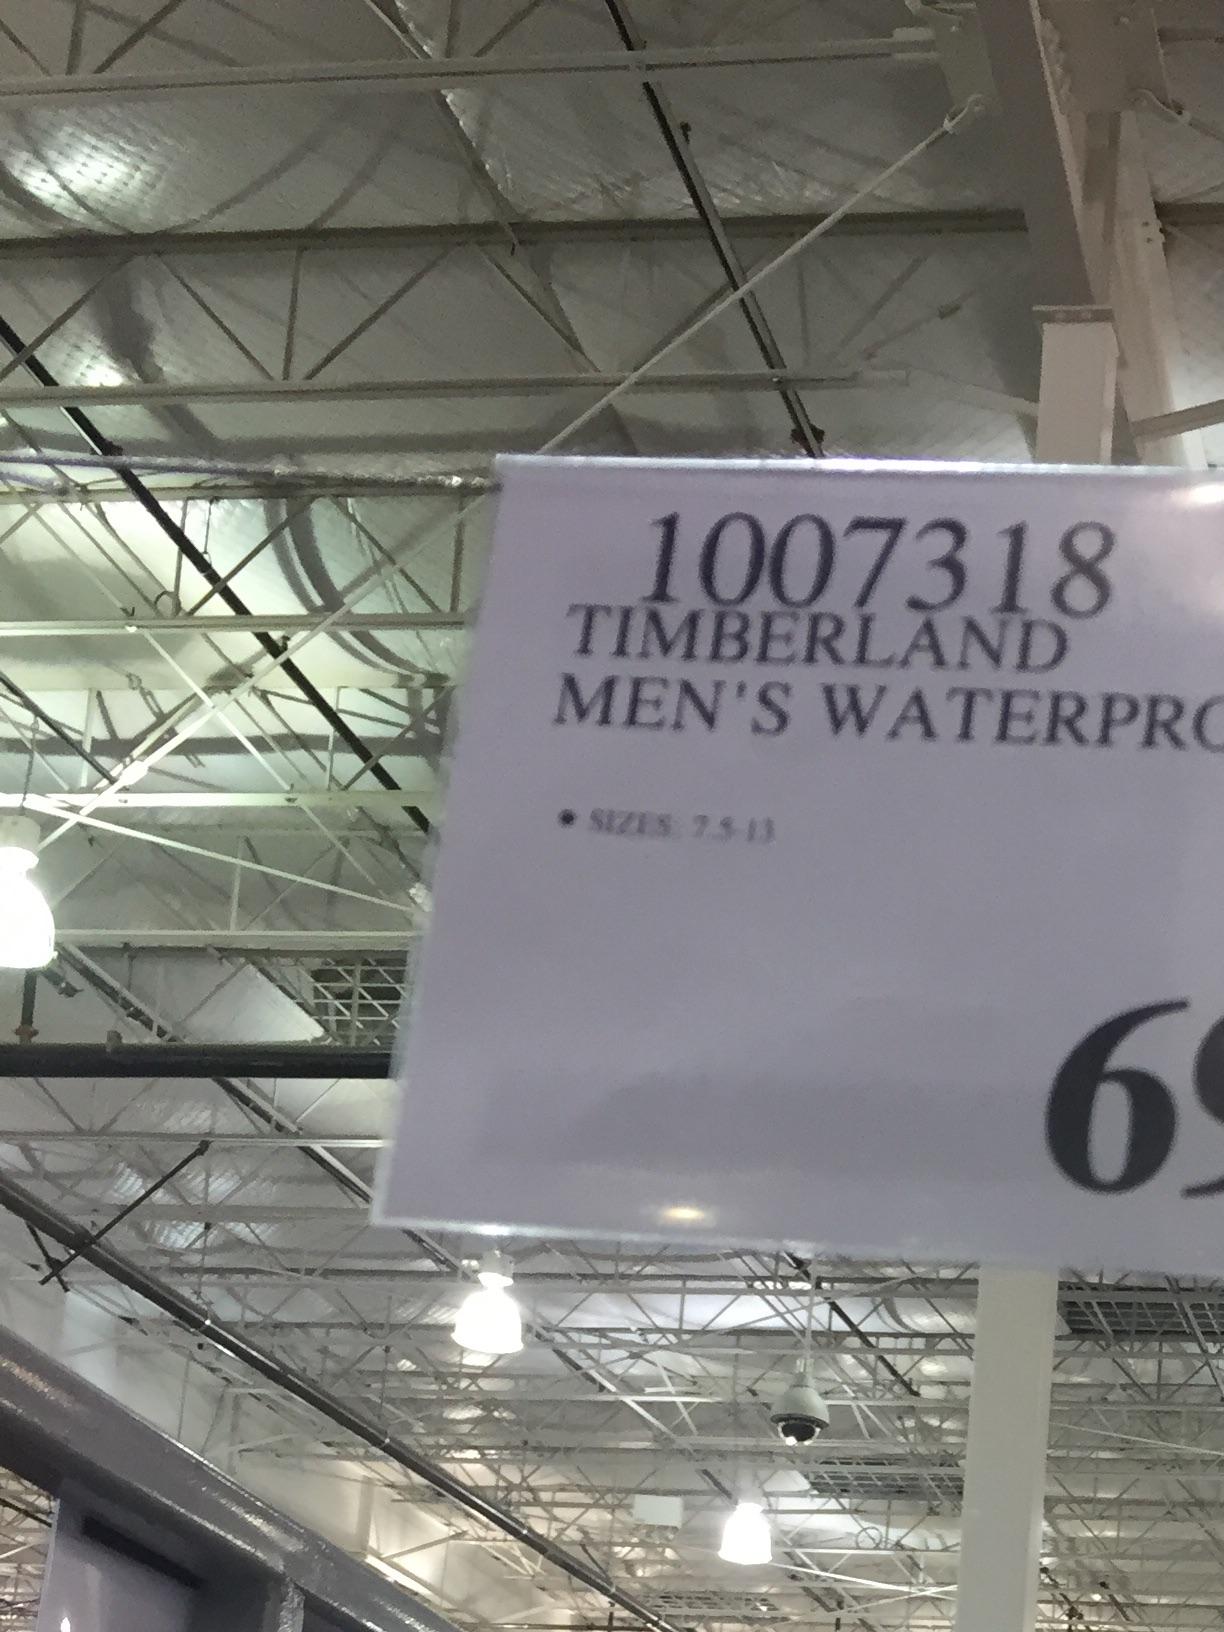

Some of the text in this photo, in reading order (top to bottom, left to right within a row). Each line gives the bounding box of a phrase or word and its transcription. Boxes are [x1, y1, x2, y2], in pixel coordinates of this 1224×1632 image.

[642, 510, 1117, 620] 1007318
[566, 603, 1070, 674] TIMBERLAND
[553, 673, 793, 736] MEN'S
